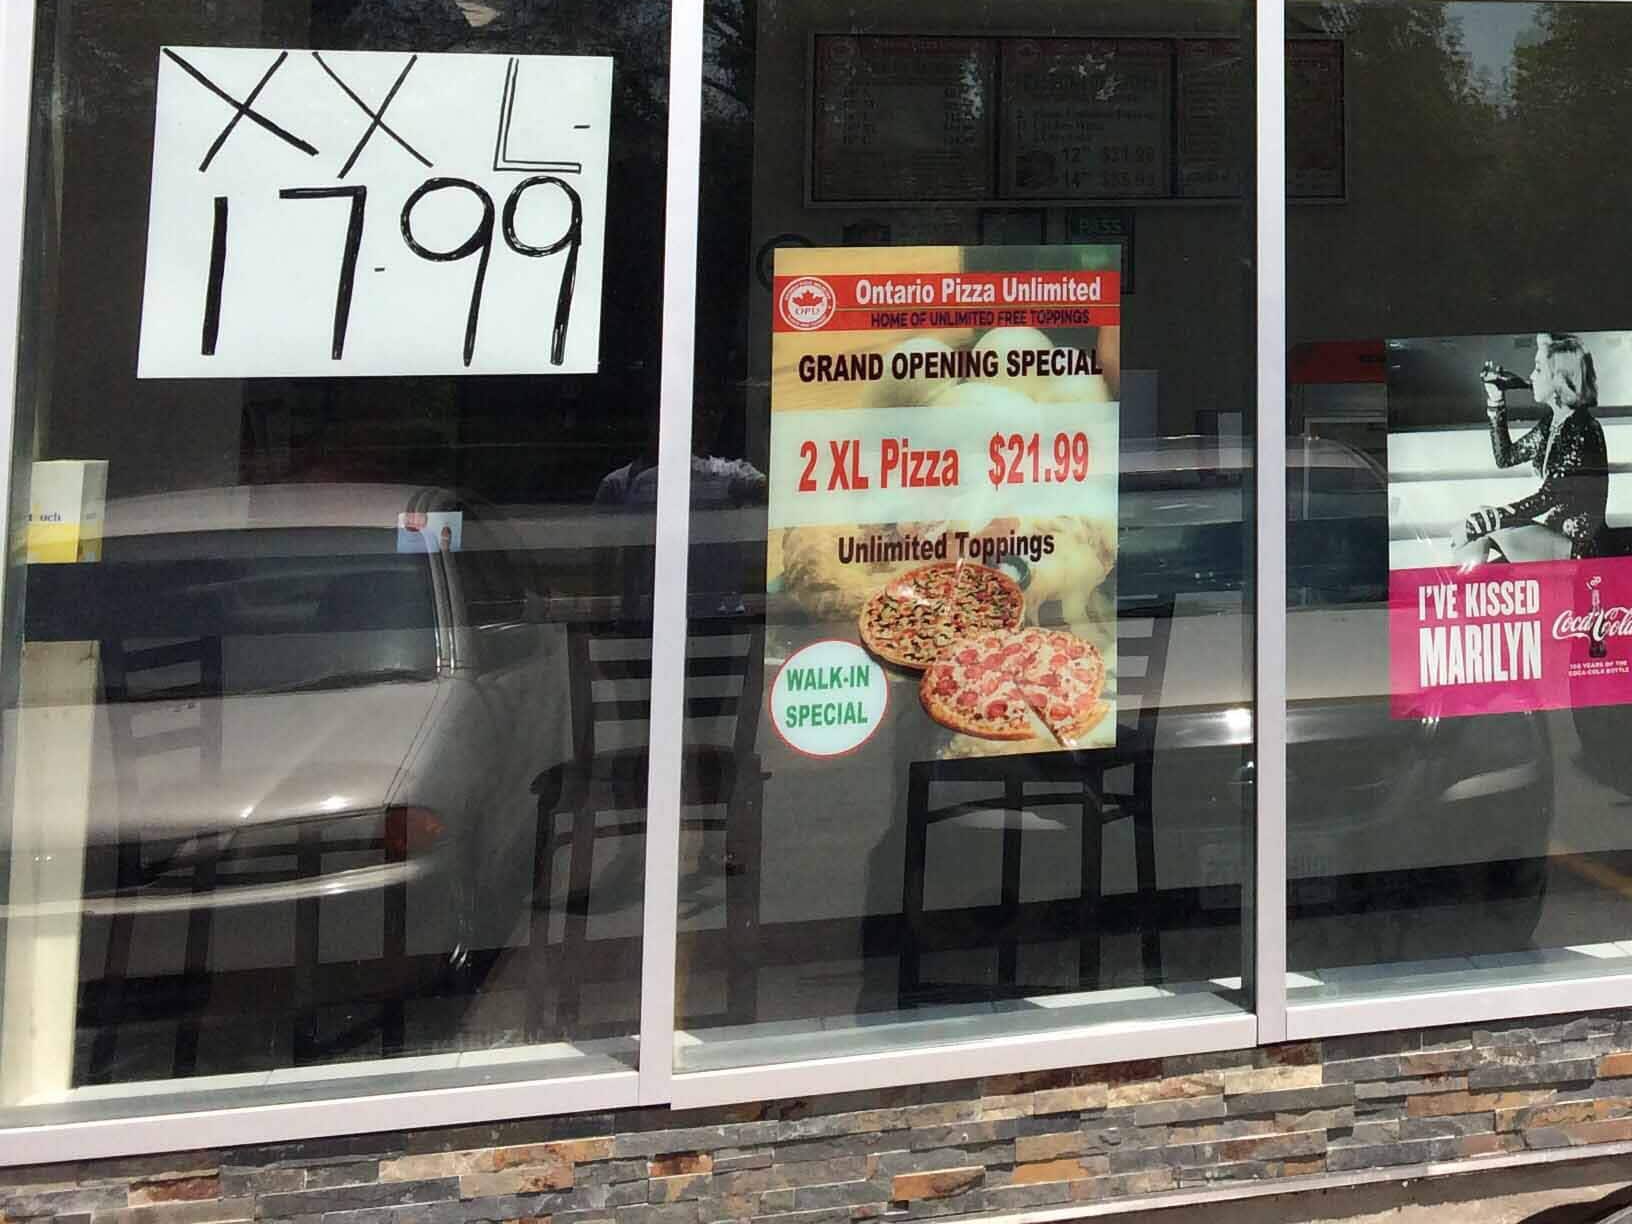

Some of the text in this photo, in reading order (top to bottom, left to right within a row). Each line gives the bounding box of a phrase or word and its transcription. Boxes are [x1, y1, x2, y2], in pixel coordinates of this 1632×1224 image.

[855, 279, 935, 305] Ontario
[941, 277, 996, 304] Pizza
[1002, 276, 1101, 303] Unlimited
[871, 308, 1090, 327] HOME OF UNLIMITED FREE TOPPINGS
[798, 349, 1103, 383] GRAND OPENING SPECIAL
[798, 431, 1090, 493] 2 XL Pizza $21.99
[837, 531, 1056, 566] Unlimited Toppings
[1418, 579, 1541, 621] I'VE KISSED
[1419, 621, 1543, 688] MARILYN
[786, 664, 871, 693] WALK-IN
[785, 701, 868, 728] SPECIAL
